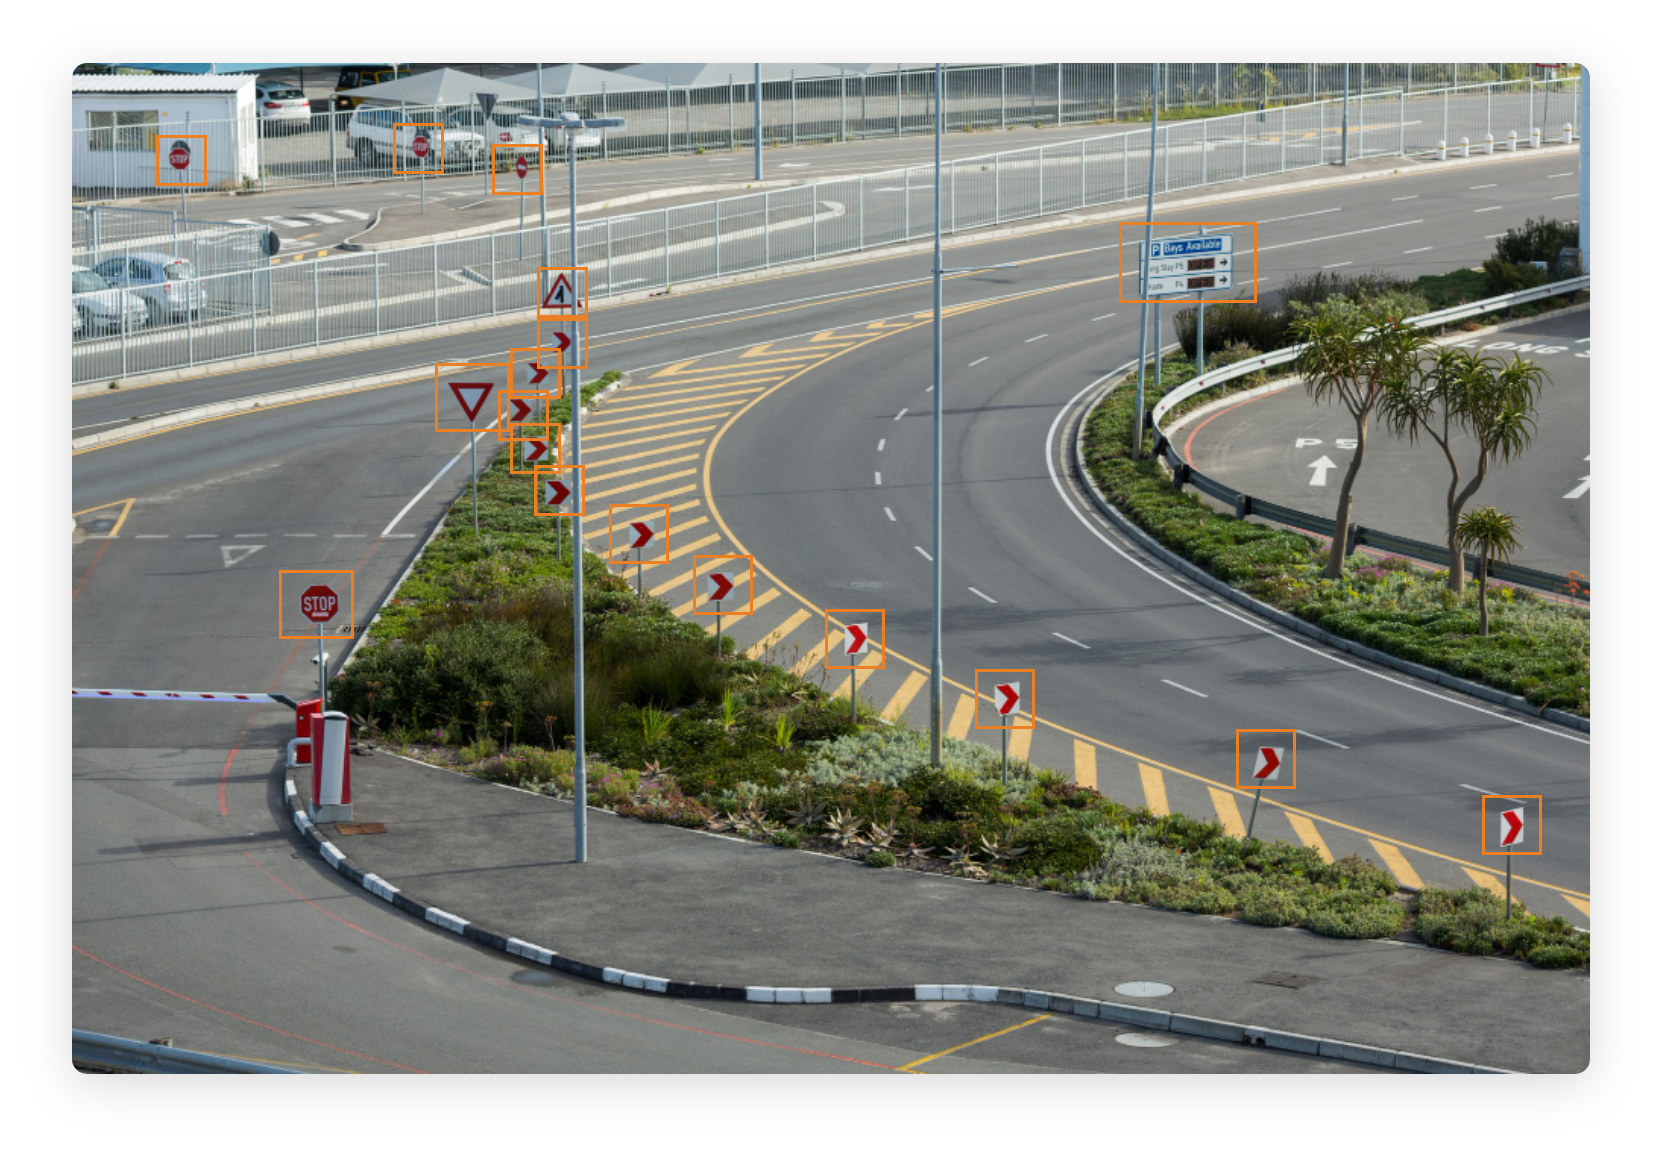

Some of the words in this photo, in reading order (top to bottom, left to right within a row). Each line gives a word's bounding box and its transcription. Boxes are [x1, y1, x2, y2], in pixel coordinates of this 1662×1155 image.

[412, 142, 427, 151] STOP
[171, 154, 187, 163] STOP
[1164, 242, 1184, 255] Bays
[1186, 238, 1221, 251] Available
[1453, 340, 1569, 354] LONG
[304, 596, 336, 612] STOP
